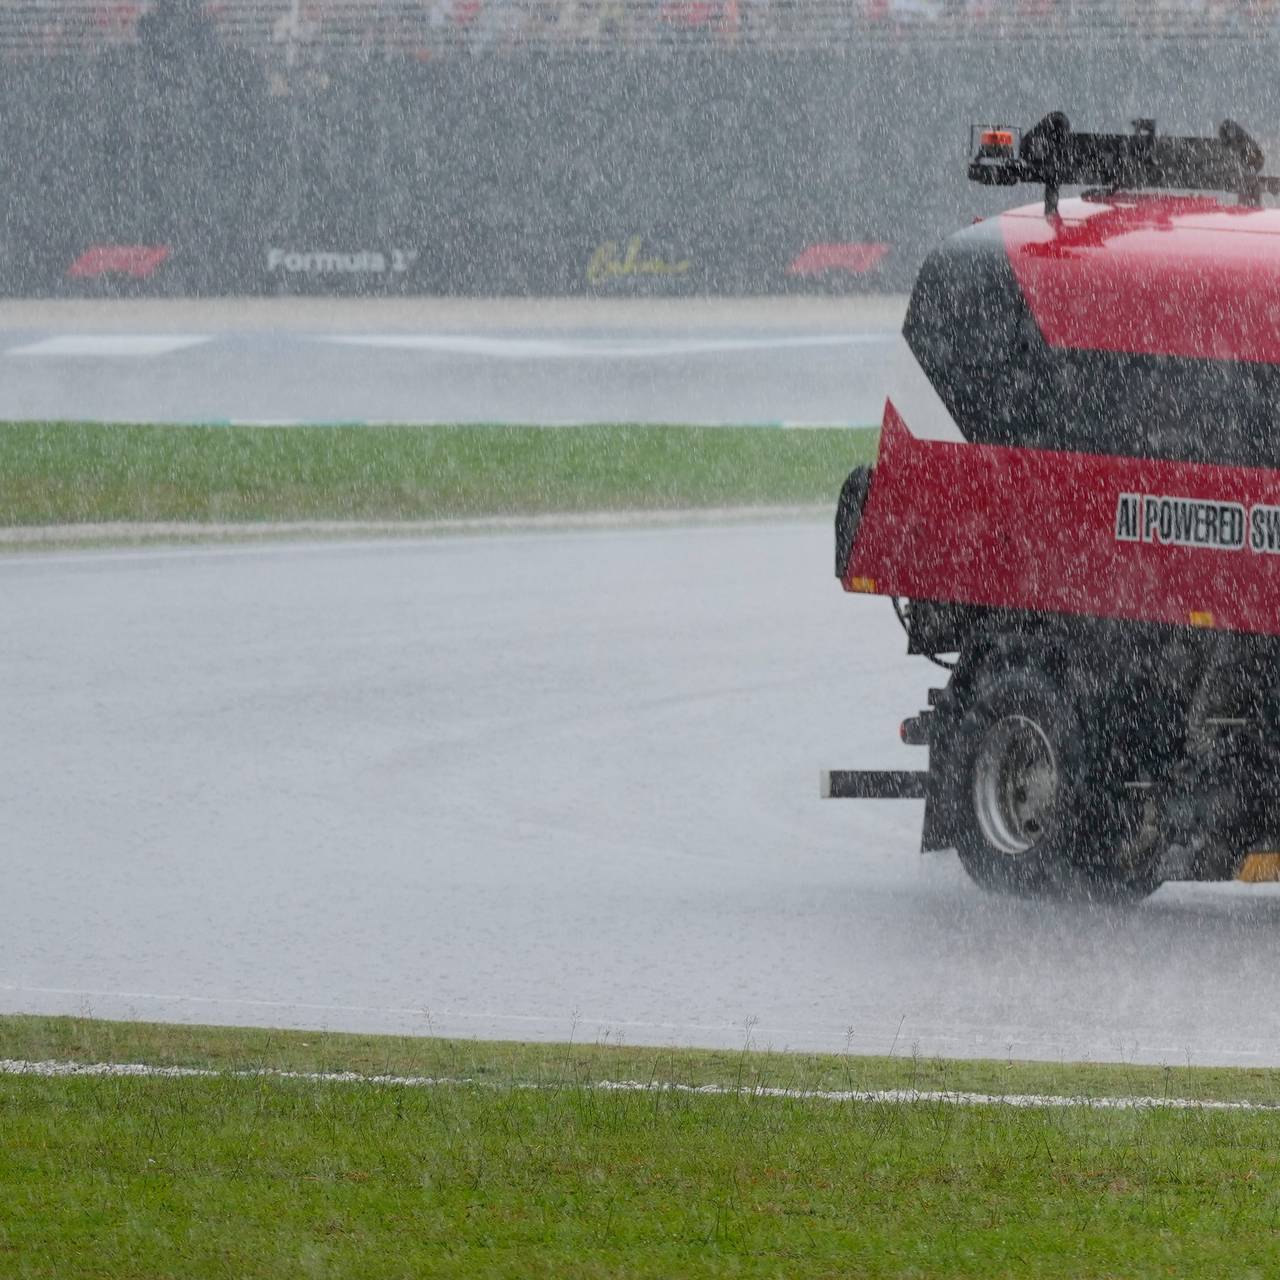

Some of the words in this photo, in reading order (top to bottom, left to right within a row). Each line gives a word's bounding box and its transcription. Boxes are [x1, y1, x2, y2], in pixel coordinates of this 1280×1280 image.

[267, 247, 386, 273] Formula
[1116, 496, 1138, 539] AI
[1143, 498, 1244, 547] POWERED
